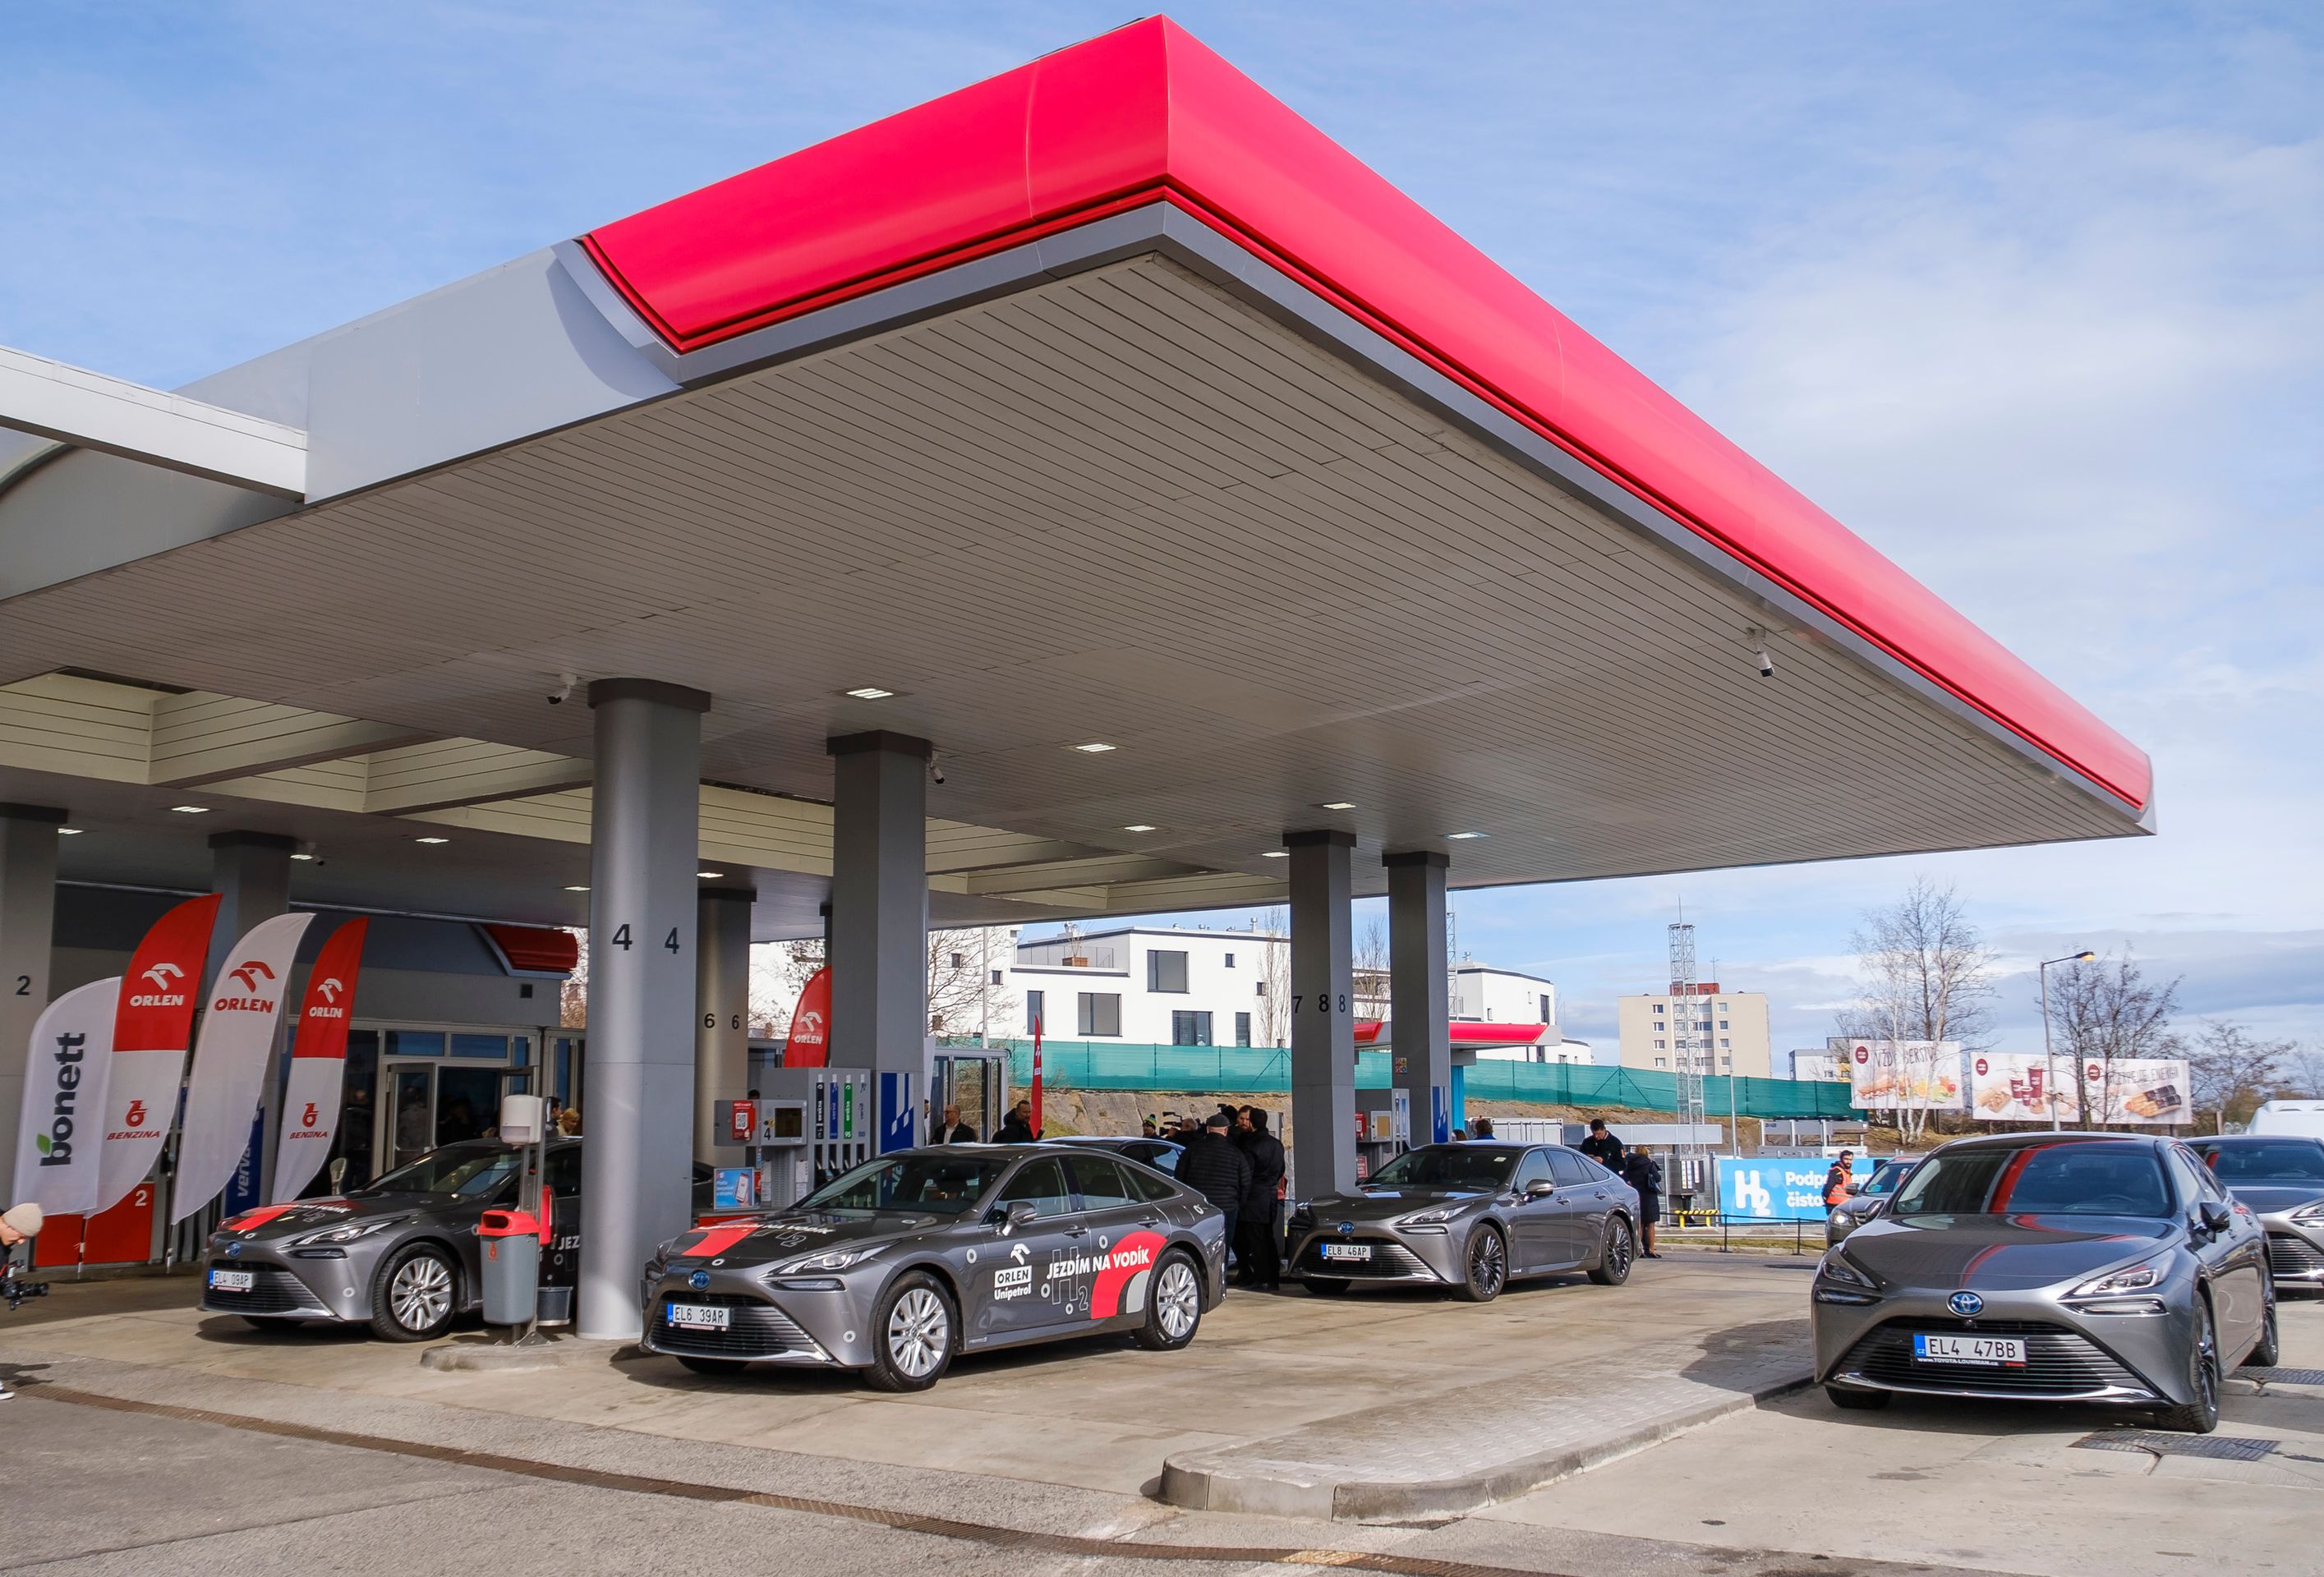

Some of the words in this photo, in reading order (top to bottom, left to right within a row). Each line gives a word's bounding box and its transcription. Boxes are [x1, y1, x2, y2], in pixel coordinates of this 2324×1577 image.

[612, 923, 633, 951] 4
[664, 926, 680, 954] 4
[16, 975, 31, 996] 2
[130, 994, 184, 1007] ORLEN
[214, 997, 274, 1014] ORLEN
[1292, 995, 1303, 1014] 7
[1318, 993, 1329, 1013] 8
[1338, 994, 1346, 1014] 8
[308, 1005, 343, 1019] ORLEN
[703, 1013, 716, 1028] 6
[731, 1014, 739, 1029] 6
[794, 1034, 822, 1046] ORLEN
[39, 1032, 86, 1166] bonett
[106, 1130, 160, 1141] BENZINA
[289, 1131, 328, 1139] BENZINA
[764, 1128, 771, 1141] 4
[135, 1189, 148, 1207] 2
[558, 1235, 580, 1250] JEZ
[1047, 1254, 1090, 1280] JEZDÍM
[1093, 1254, 1111, 1272] NA
[1112, 1245, 1150, 1268] VODÍK
[997, 1269, 1029, 1284] ORLEN
[994, 1283, 1032, 1301] Unipetrol
[674, 1307, 693, 1322] EL6
[699, 1308, 724, 1324] 39AR
[1929, 1338, 1960, 1355] EL4
[1974, 1340, 2016, 1359] 47BB
